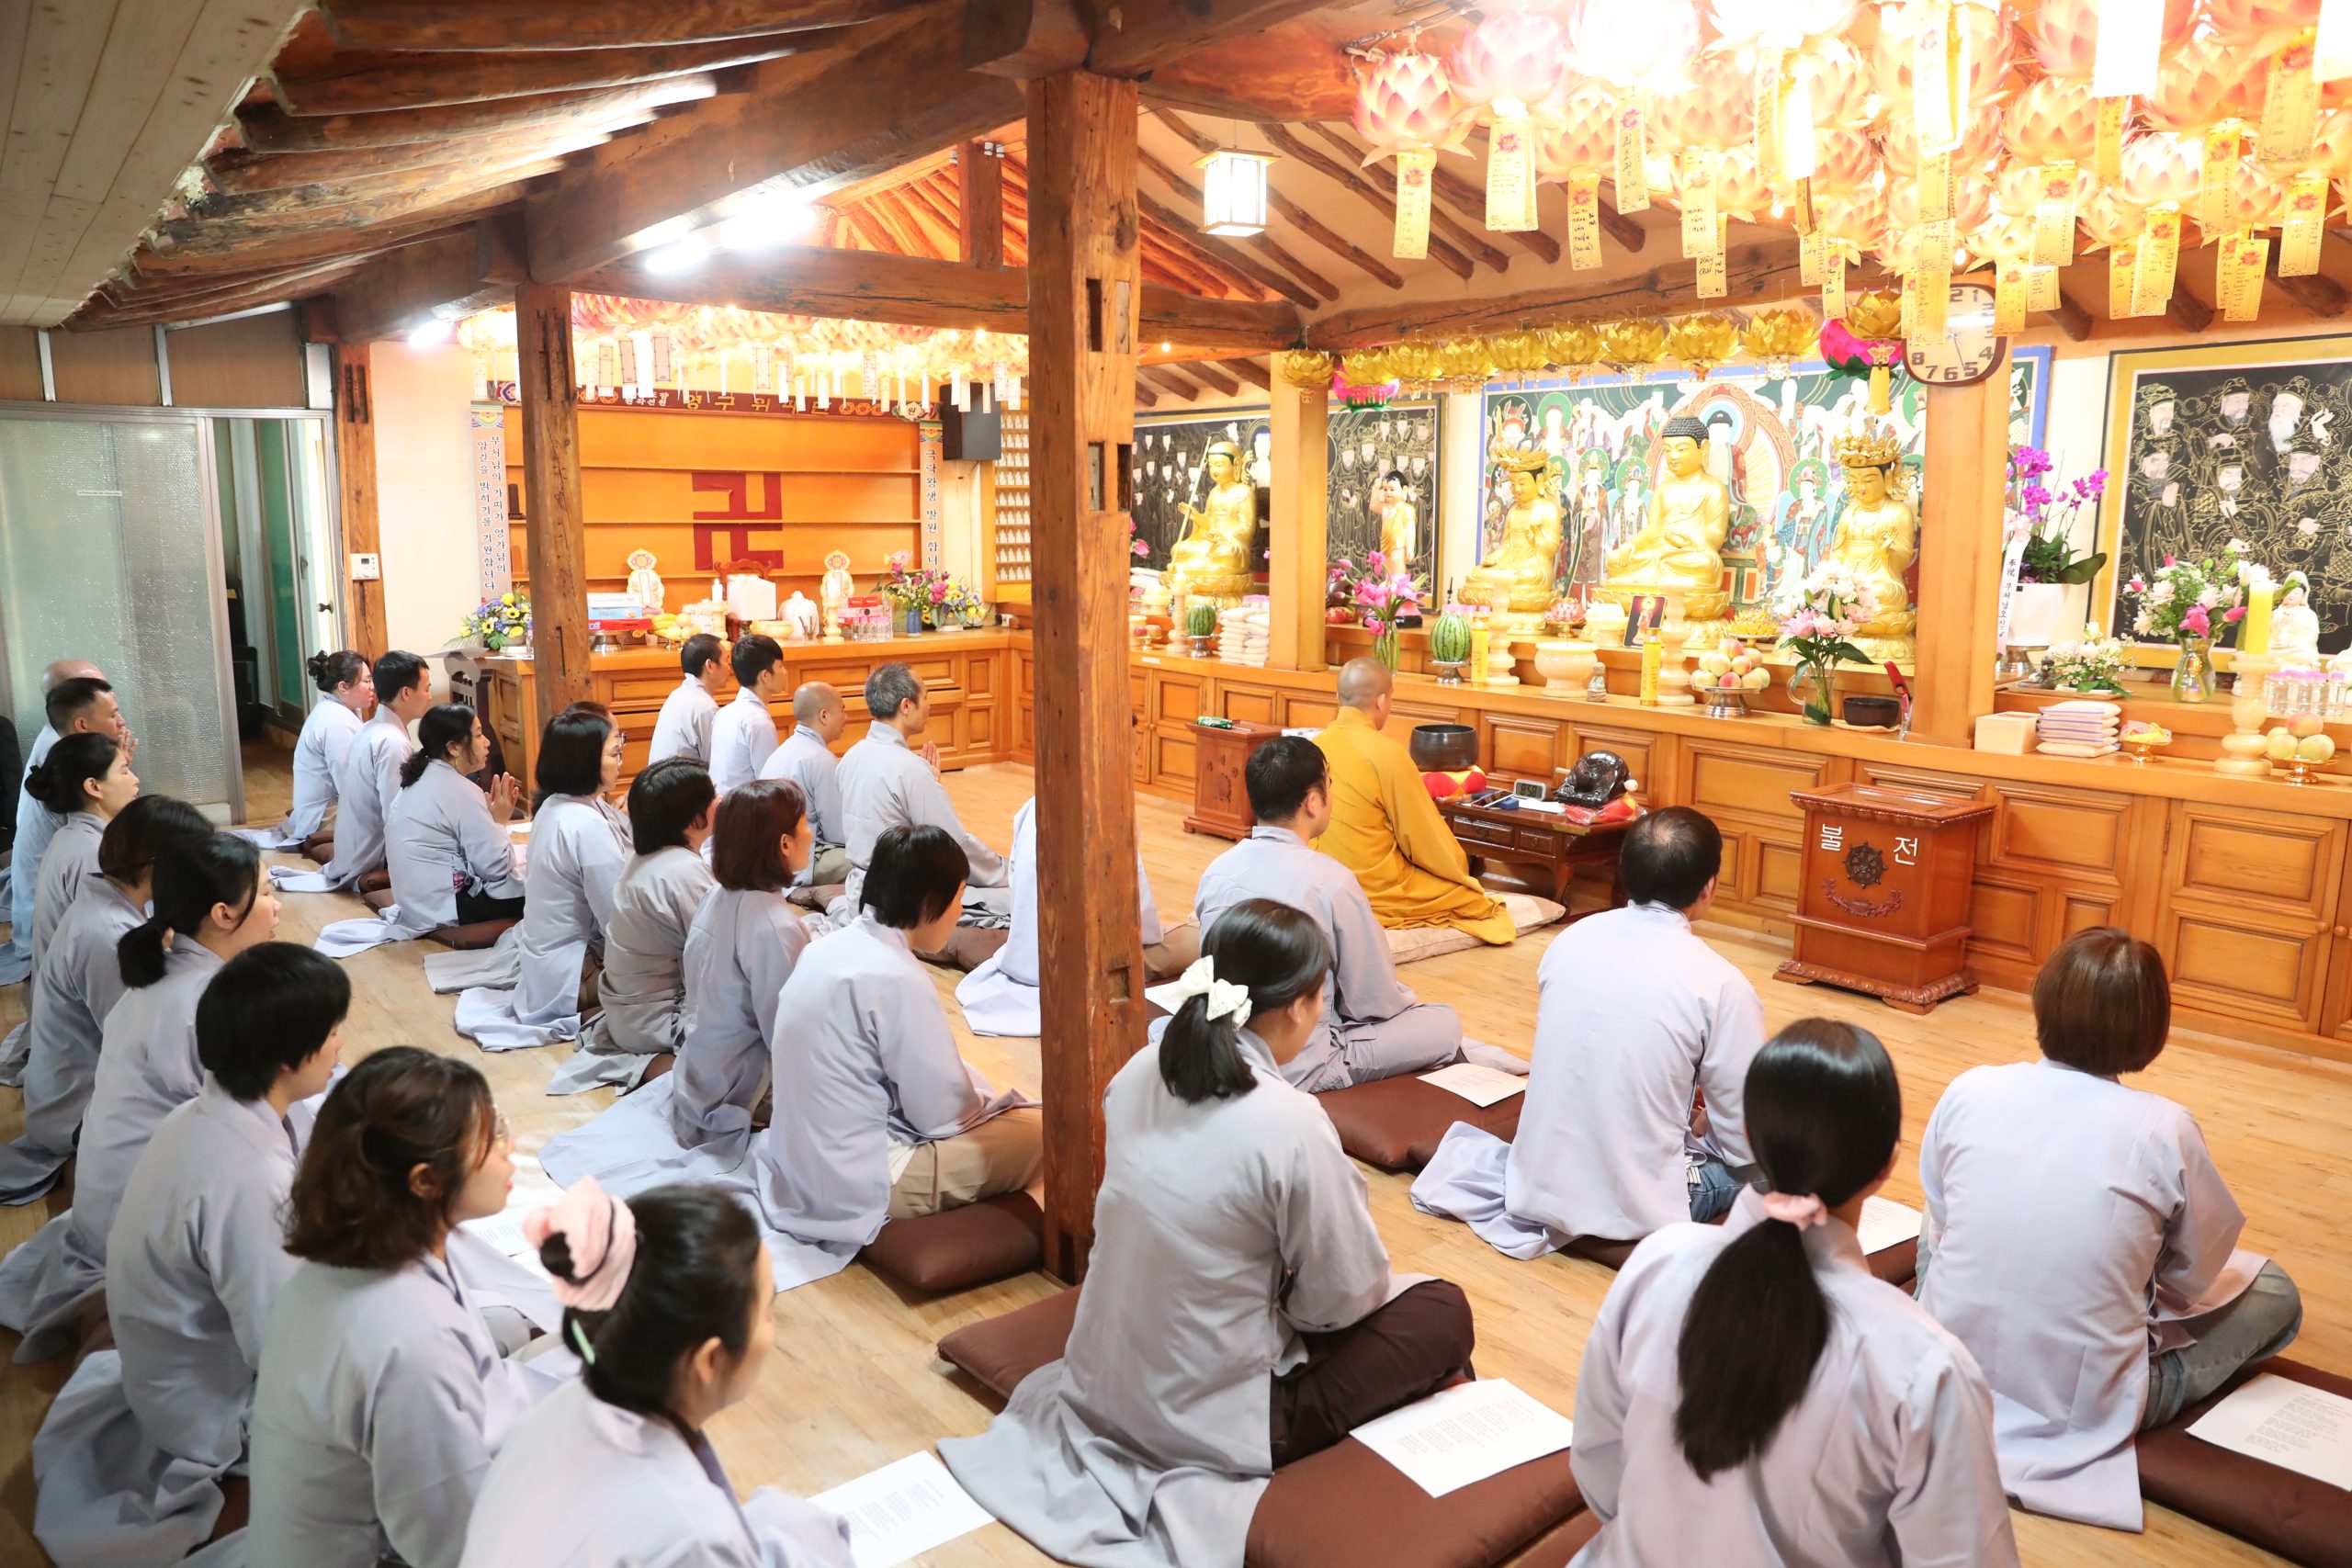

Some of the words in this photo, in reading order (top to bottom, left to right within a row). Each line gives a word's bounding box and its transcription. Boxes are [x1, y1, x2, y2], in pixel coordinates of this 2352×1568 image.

[1950, 288, 1963, 302] 2
[1972, 288, 1980, 302] 1
[1911, 352, 1925, 366] 8
[1978, 346, 1994, 360] 4
[1925, 365, 1939, 379] 7
[1943, 367, 1959, 381] 6
[1964, 361, 1979, 378] 5
[477, 441, 489, 475] 앞길을
[490, 435, 502, 481] 부처님의
[925, 449, 937, 502] 극락왕생
[492, 488, 504, 522] 가피가
[926, 509, 937, 534] 발원
[494, 528, 506, 573] 영가님의
[482, 534, 495, 591] 기원합니다
